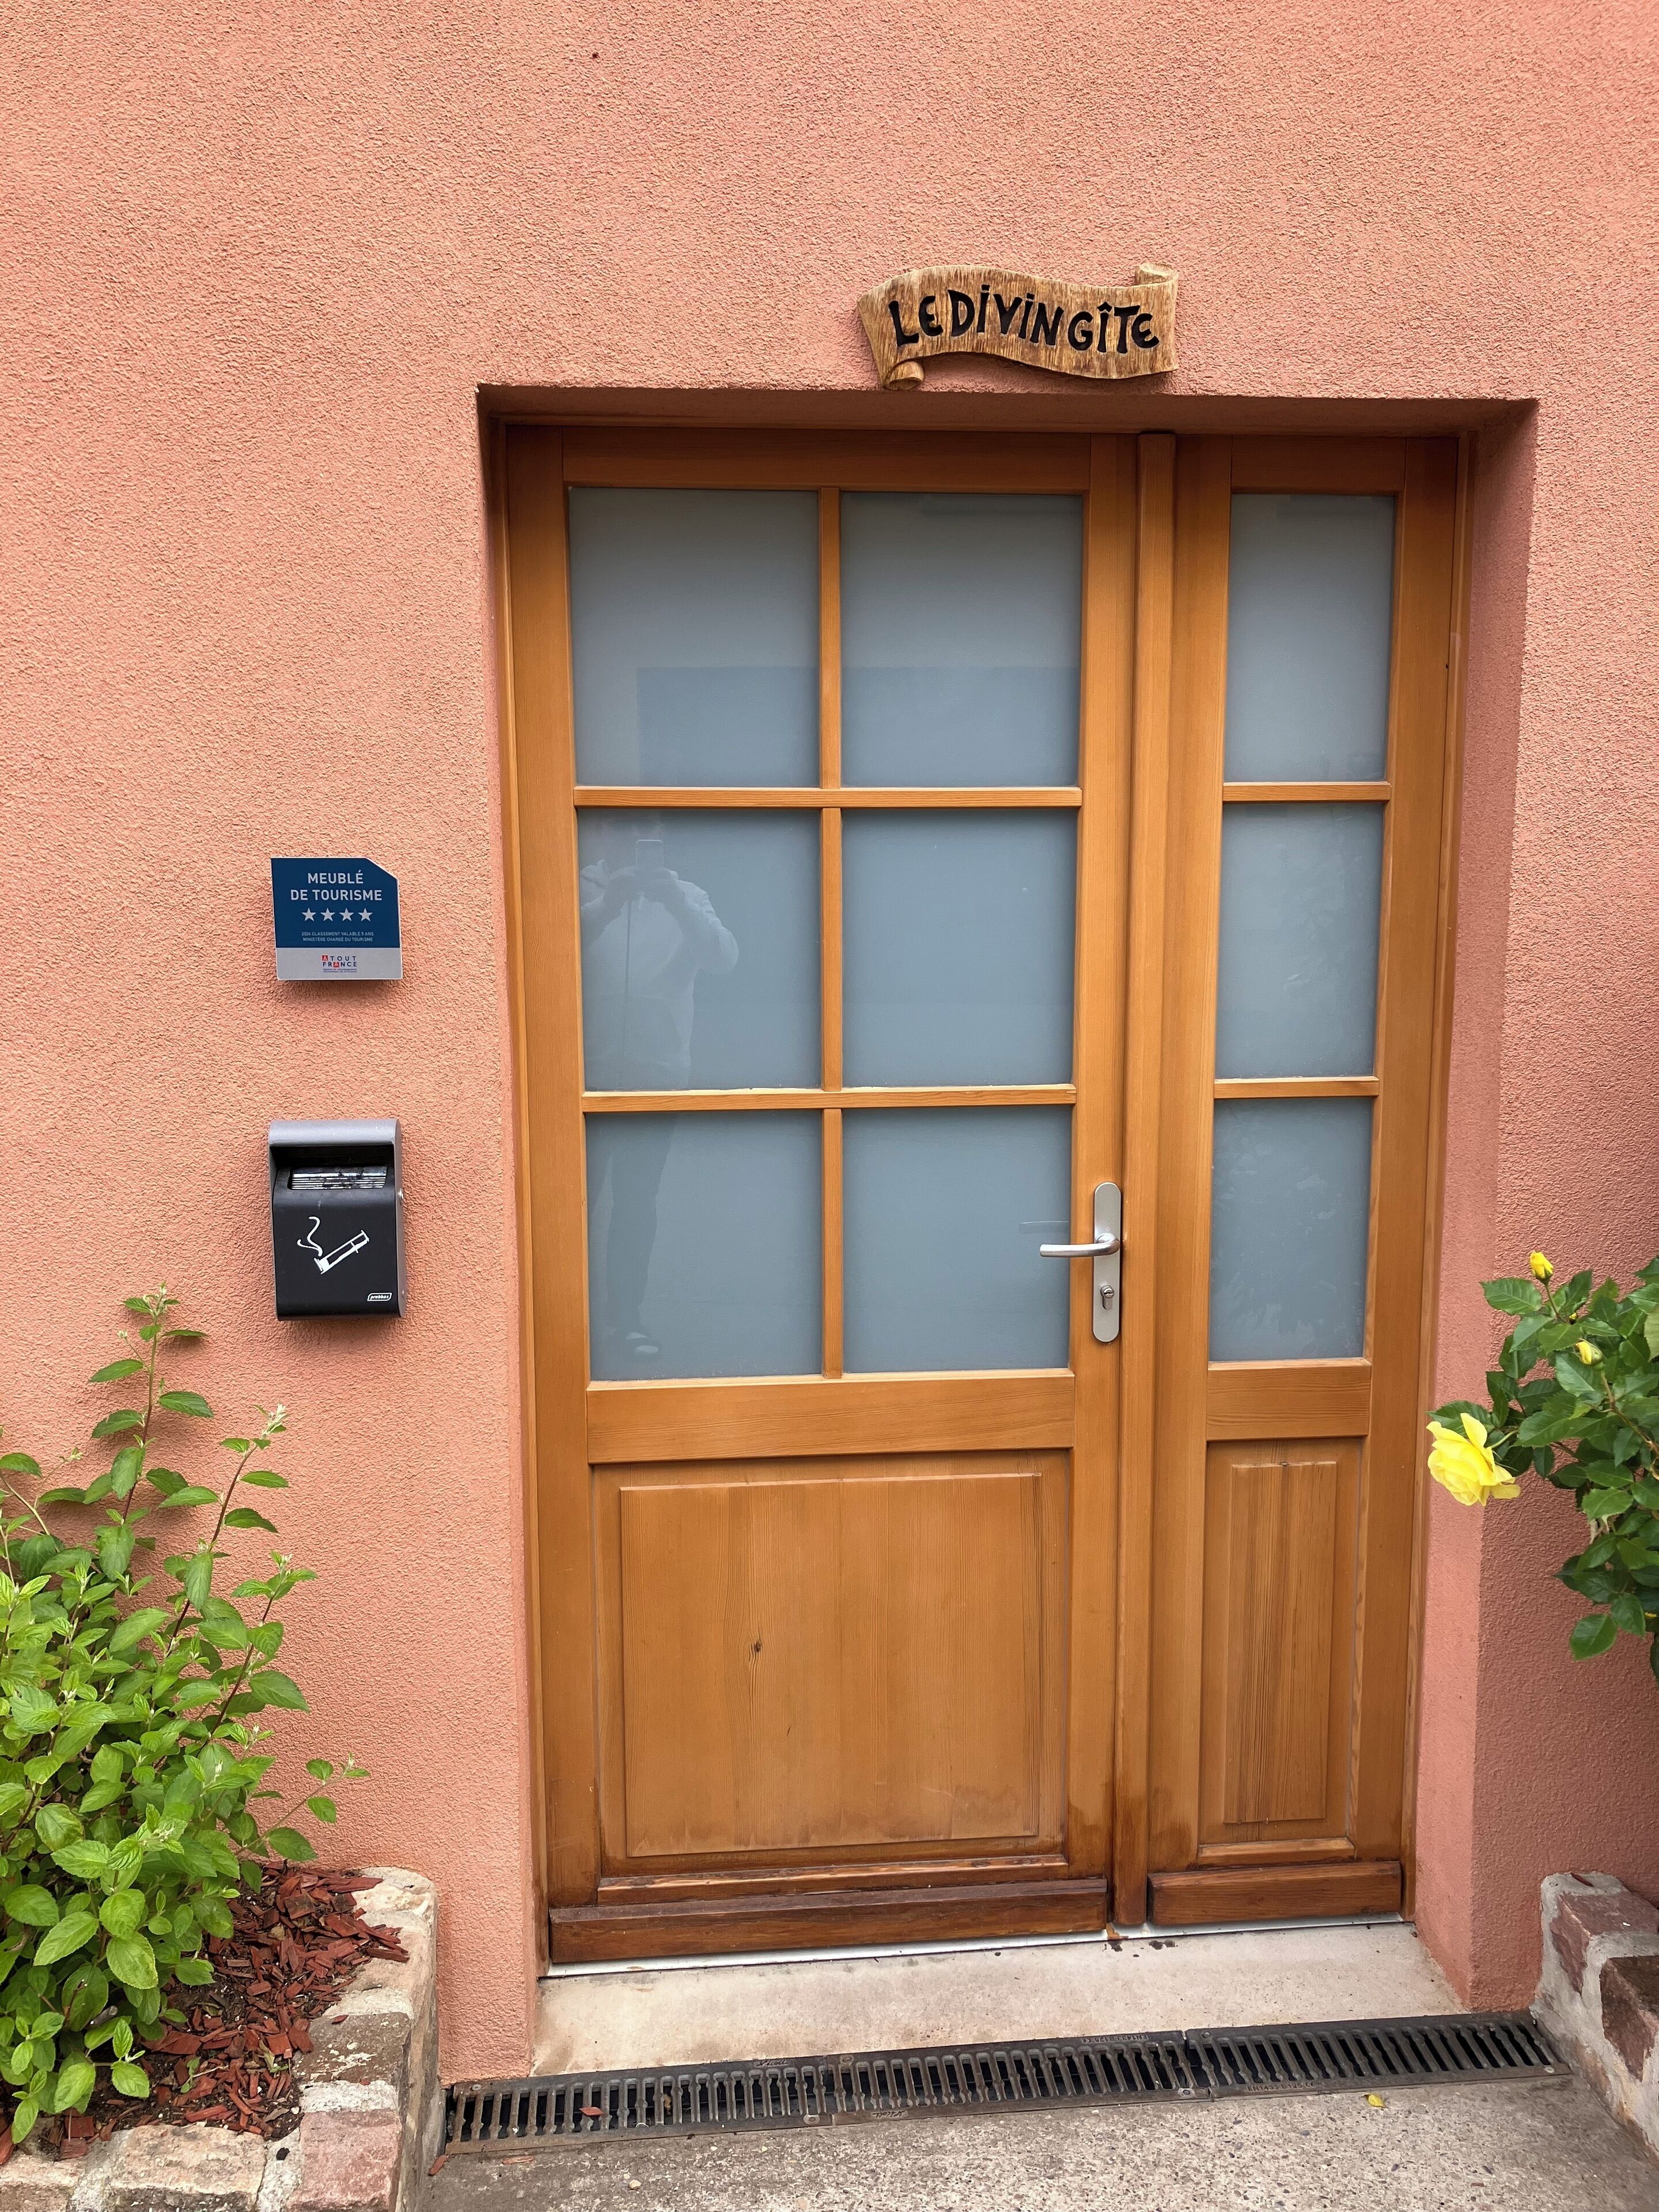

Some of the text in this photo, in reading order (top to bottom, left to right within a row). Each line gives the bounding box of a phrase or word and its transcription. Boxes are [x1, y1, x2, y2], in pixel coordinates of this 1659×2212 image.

[308, 870, 363, 884] MEUBLÉ
[290, 889, 382, 900] DE TOURISME
